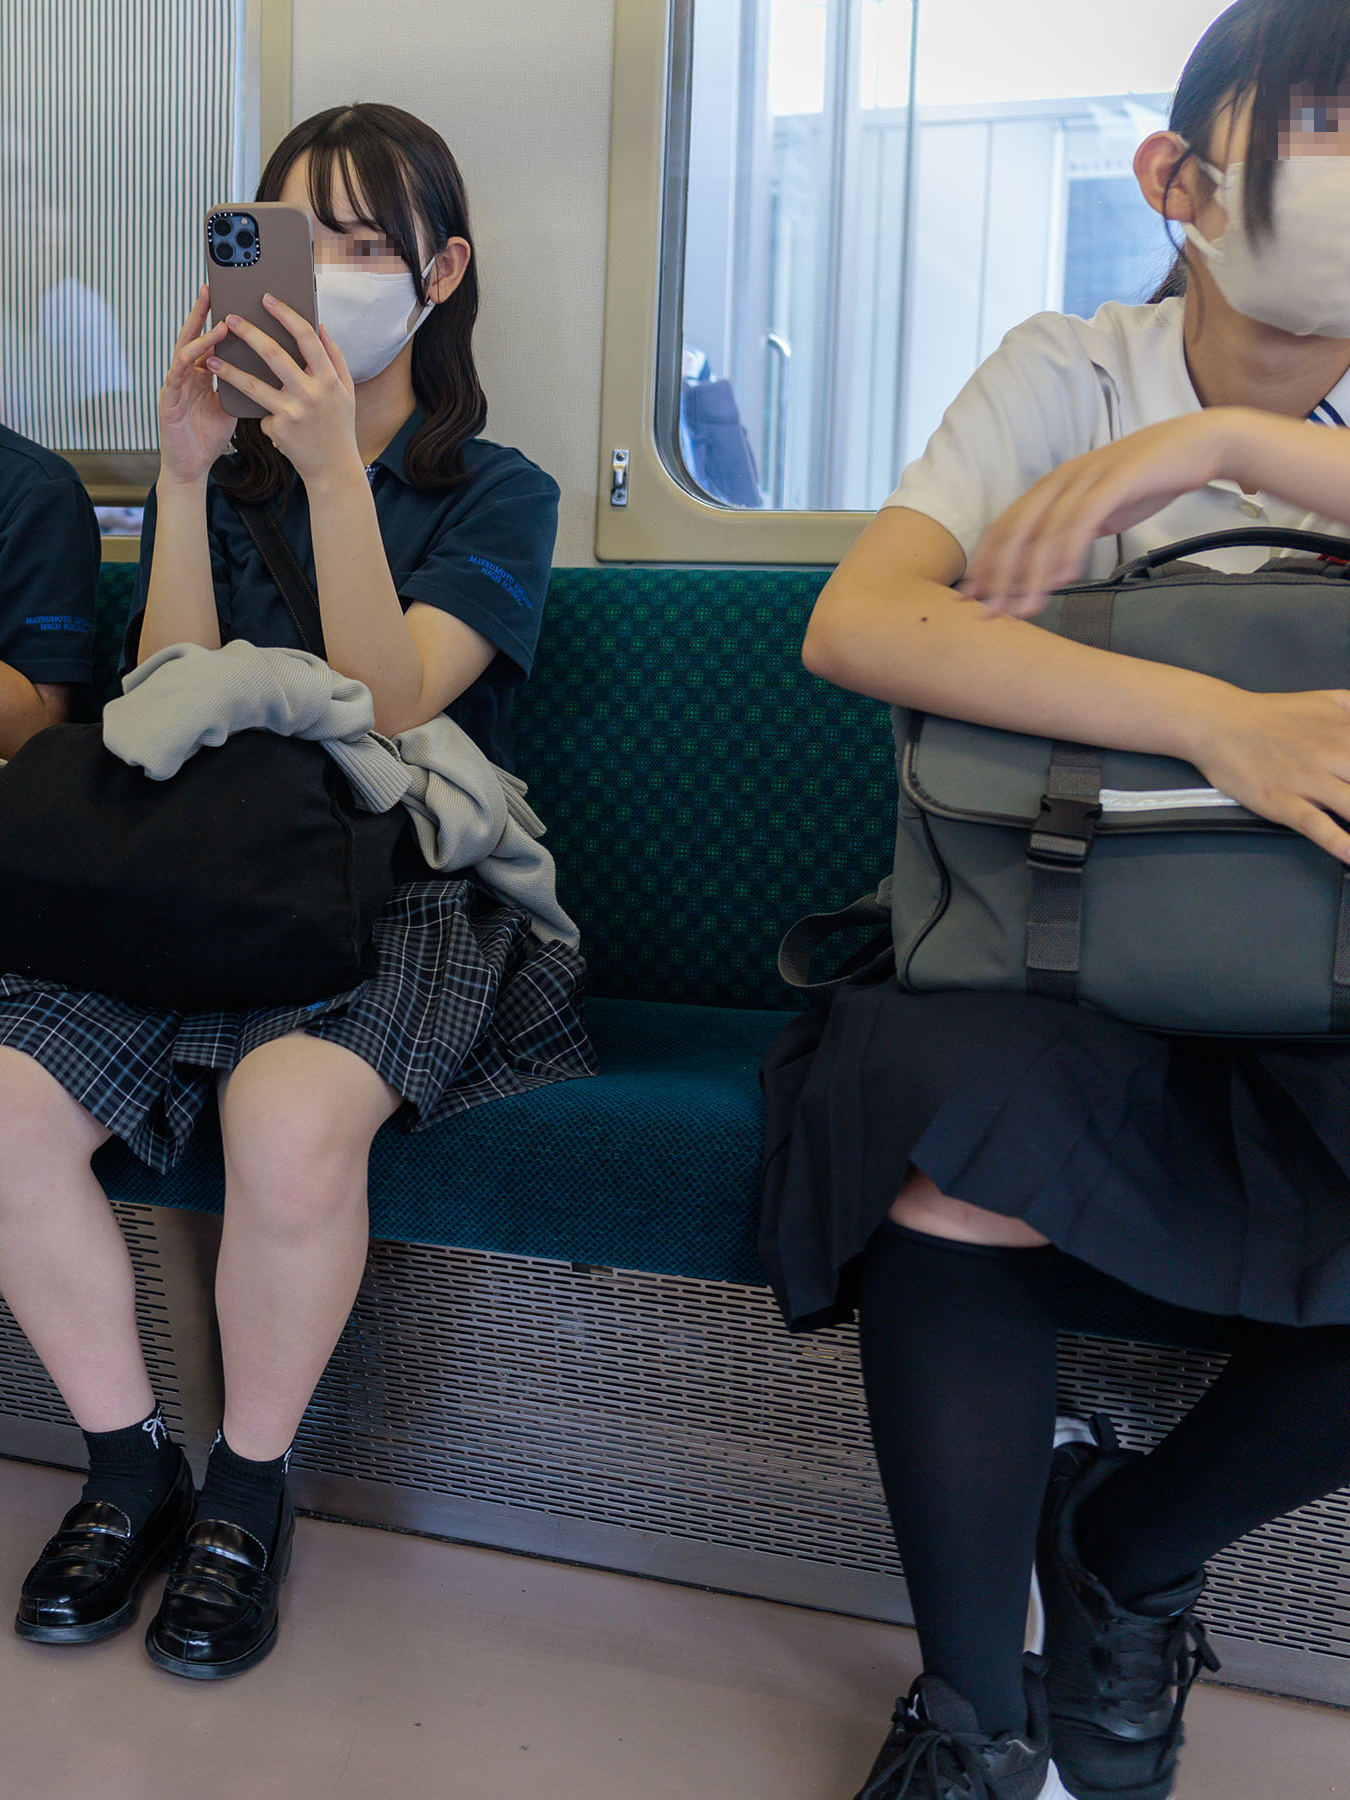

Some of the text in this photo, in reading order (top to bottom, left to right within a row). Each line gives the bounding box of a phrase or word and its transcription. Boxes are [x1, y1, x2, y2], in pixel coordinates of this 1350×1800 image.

[469, 554, 515, 584] MATSUMOTO
[481, 567, 502, 583] HIGH
[25, 615, 73, 624] MATSUMOTO
[40, 623, 61, 631] HIGH
